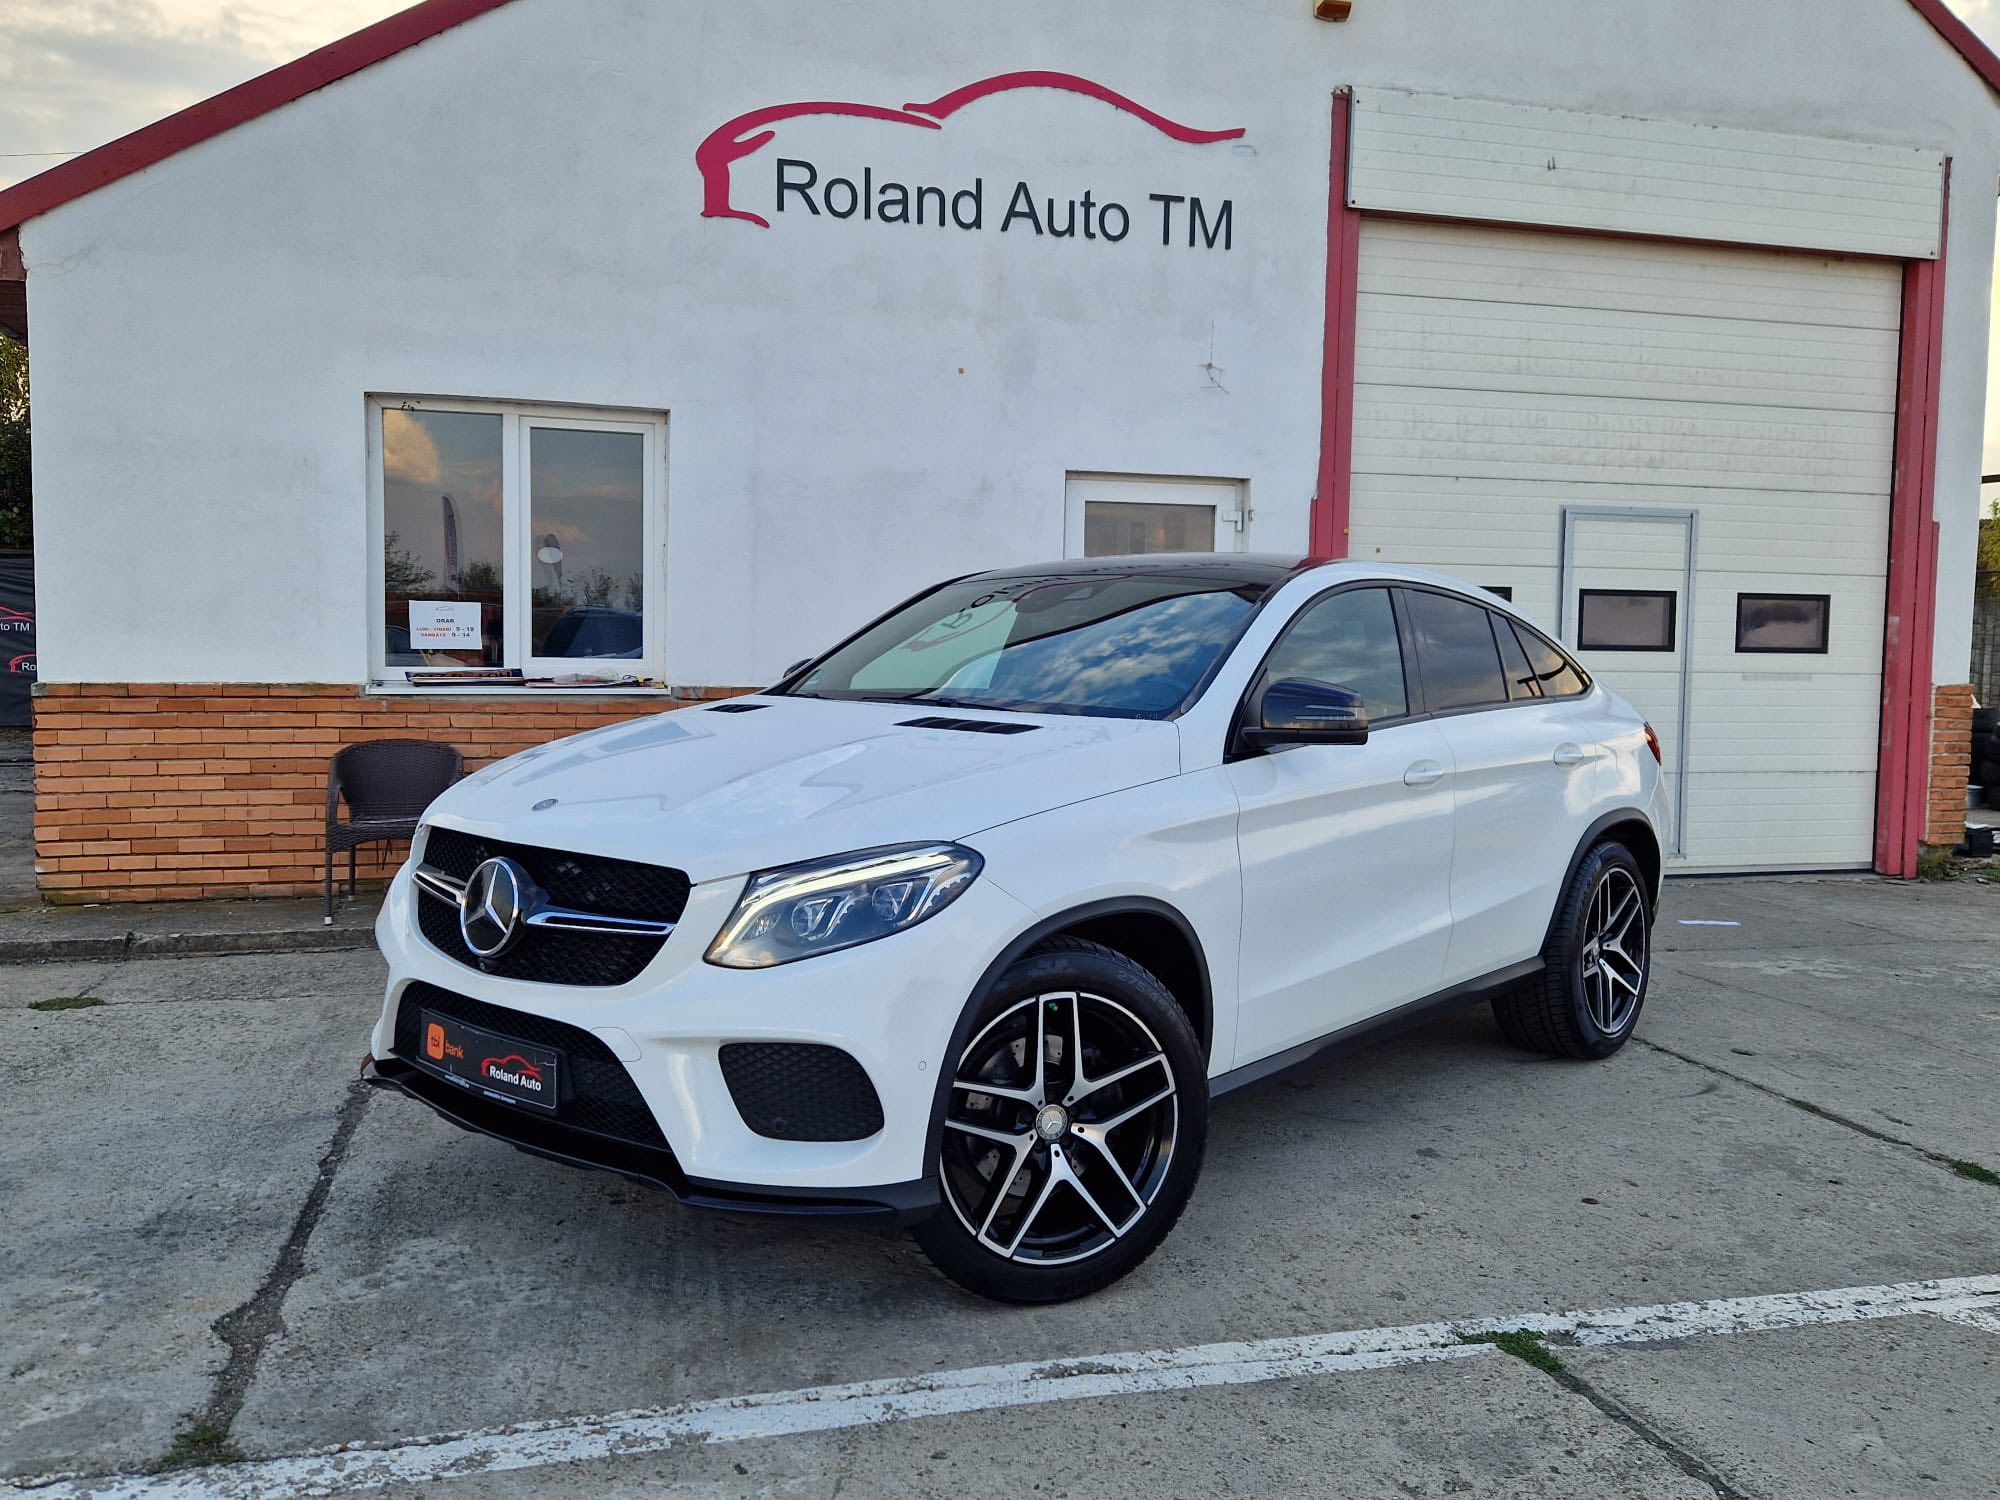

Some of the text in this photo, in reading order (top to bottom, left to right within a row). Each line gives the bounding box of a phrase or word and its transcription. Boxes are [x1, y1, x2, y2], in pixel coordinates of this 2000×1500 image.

[775, 158, 1234, 251] Roland Auto TM
[13, 622, 30, 631] TM
[21, 662, 37, 671] Ro
[430, 1035, 464, 1059] tbi bank
[489, 1065, 519, 1085] Roland
[520, 1075, 541, 1091] Auto
